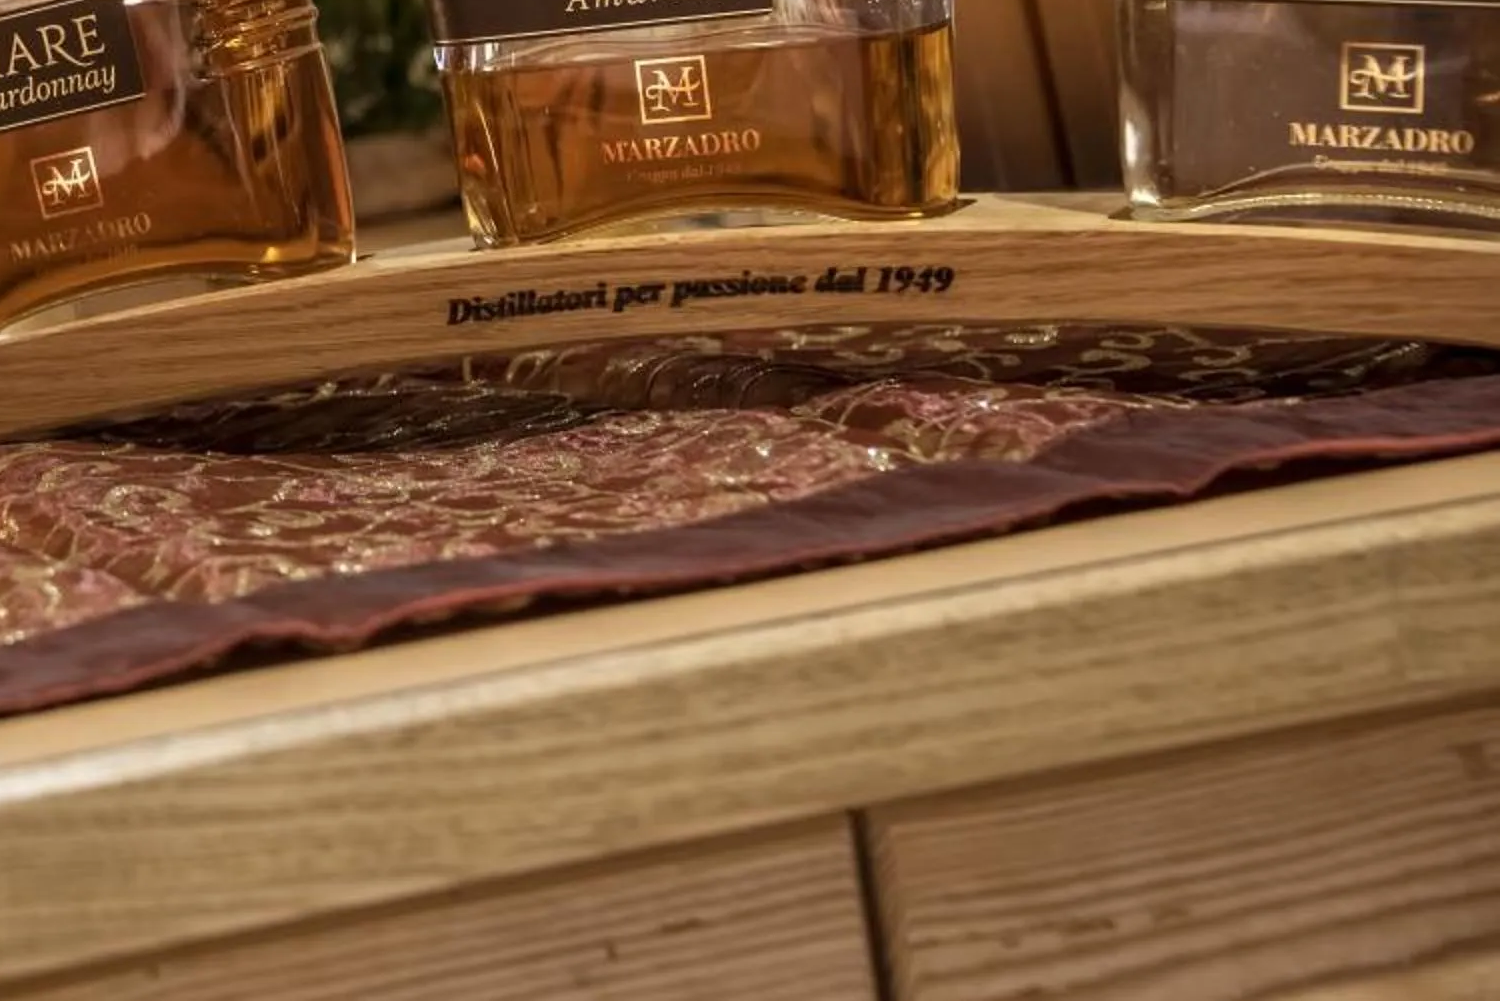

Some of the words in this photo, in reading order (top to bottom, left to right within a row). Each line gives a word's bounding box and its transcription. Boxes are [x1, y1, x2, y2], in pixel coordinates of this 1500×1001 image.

[601, 128, 761, 164] MARZADRO
[1288, 121, 1475, 155] MARZADRO
[446, 282, 607, 326] Distillatori
[612, 282, 667, 313] per
[669, 269, 808, 308] passione
[814, 266, 867, 294] dal
[874, 266, 956, 294] 1949
